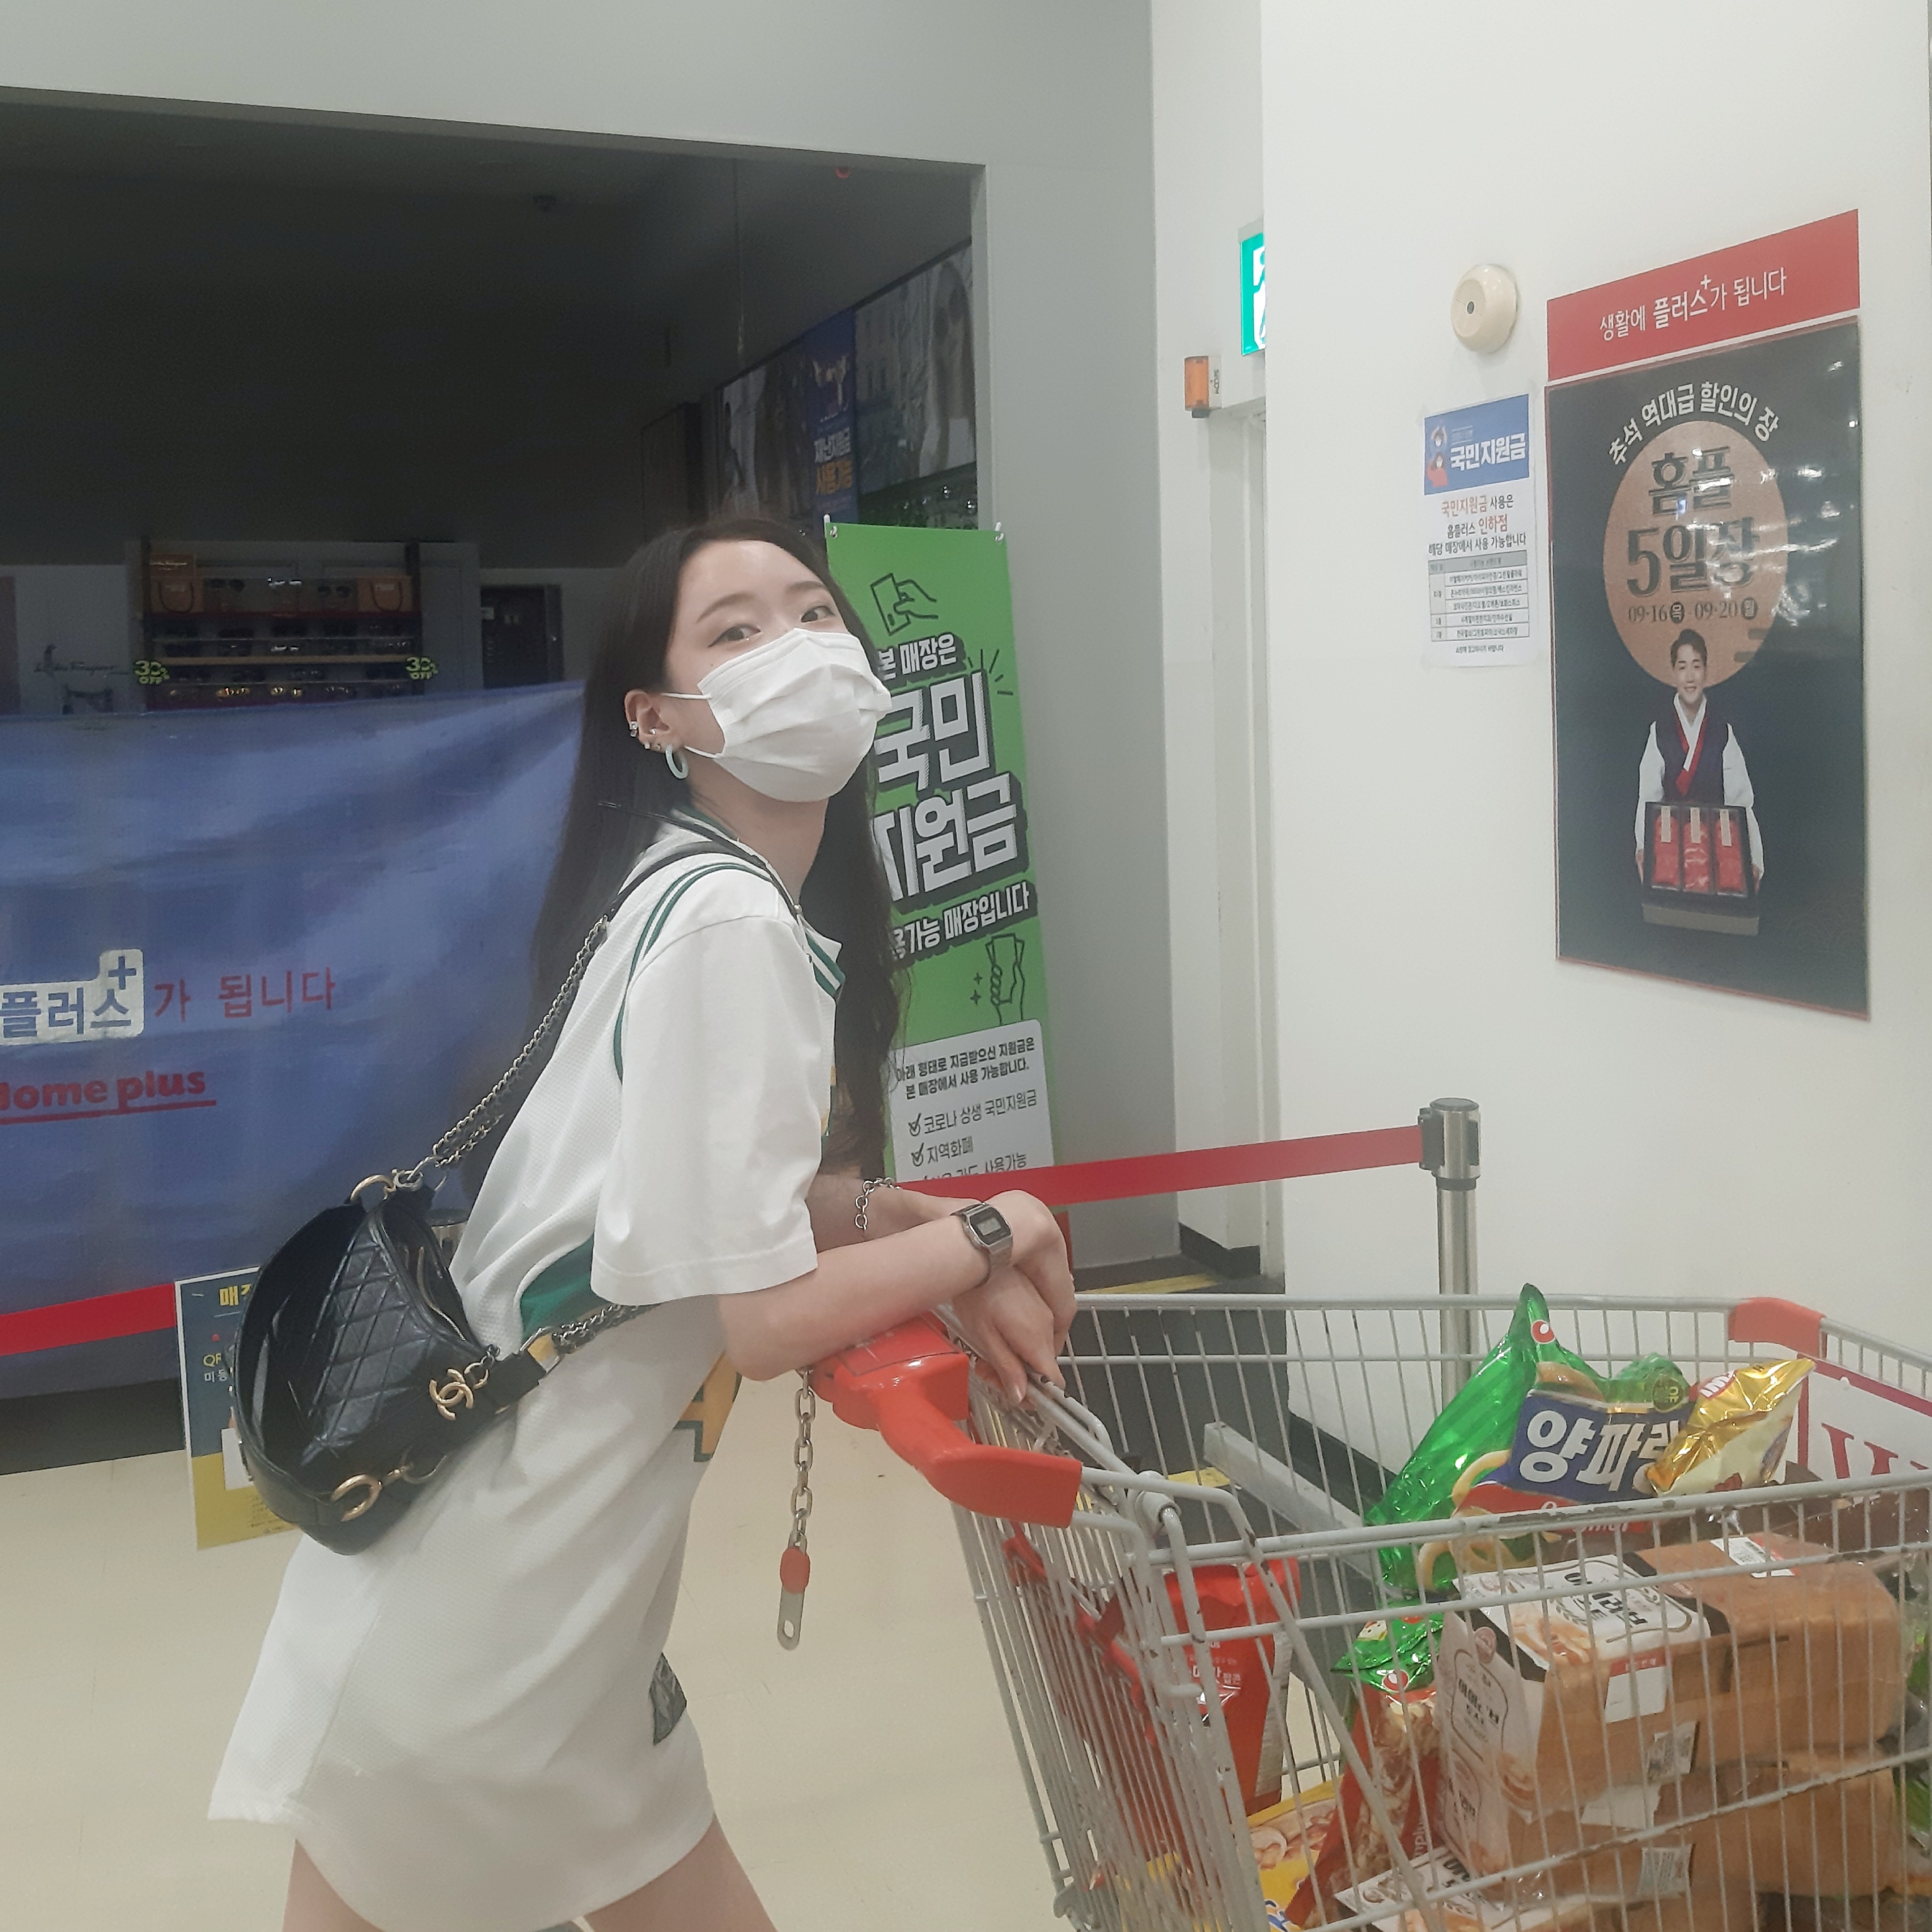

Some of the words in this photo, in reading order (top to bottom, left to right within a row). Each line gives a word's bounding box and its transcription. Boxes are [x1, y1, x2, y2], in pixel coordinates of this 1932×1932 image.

[1600, 306, 1646, 341] 생활에
[1734, 267, 1787, 307] 됩니다
[1609, 418, 1643, 465] 추석
[1641, 384, 1694, 428] 역대급
[1700, 381, 1758, 426] 할인의
[1753, 406, 1779, 441] 장
[1450, 432, 1526, 472] 국민지원금
[1648, 446, 1735, 518] 홈플
[1441, 495, 1487, 518] 국민지원금
[1490, 494, 1514, 510] 사용은
[1447, 522, 1475, 539] 홈플러스
[1478, 514, 1507, 535] 인하점
[1428, 543, 1443, 556] 해당
[1445, 539, 1472, 553] 매장에서
[1475, 537, 1489, 551] 사용
[1491, 533, 1526, 548] 가능합니다
[1627, 516, 1760, 598] 5일장
[410, 671, 433, 680] OFF
[879, 647, 897, 681] 본
[899, 633, 957, 675] 매장은
[139, 676, 163, 685] OFF
[874, 671, 991, 791] 국민
[873, 773, 1018, 902] 지원금
[944, 881, 1030, 941] 매장입니다
[218, 966, 336, 1019] 됩니다
[896, 1063, 916, 1082] 아래
[918, 1057, 947, 1077] 형태로
[950, 1045, 996, 1069] 지급받으신
[999, 1037, 1035, 1056] 지원금은
[116, 1071, 206, 1111] plus
[906, 1084, 916, 1100] 본
[919, 1074, 958, 1097] 매장에서
[960, 1069, 979, 1085] 사용
[923, 1110, 957, 1134] 코로나
[960, 1102, 982, 1124] 상생
[985, 1089, 1037, 1116] 국민지원금
[985, 1152, 1027, 1174] 사용가능
